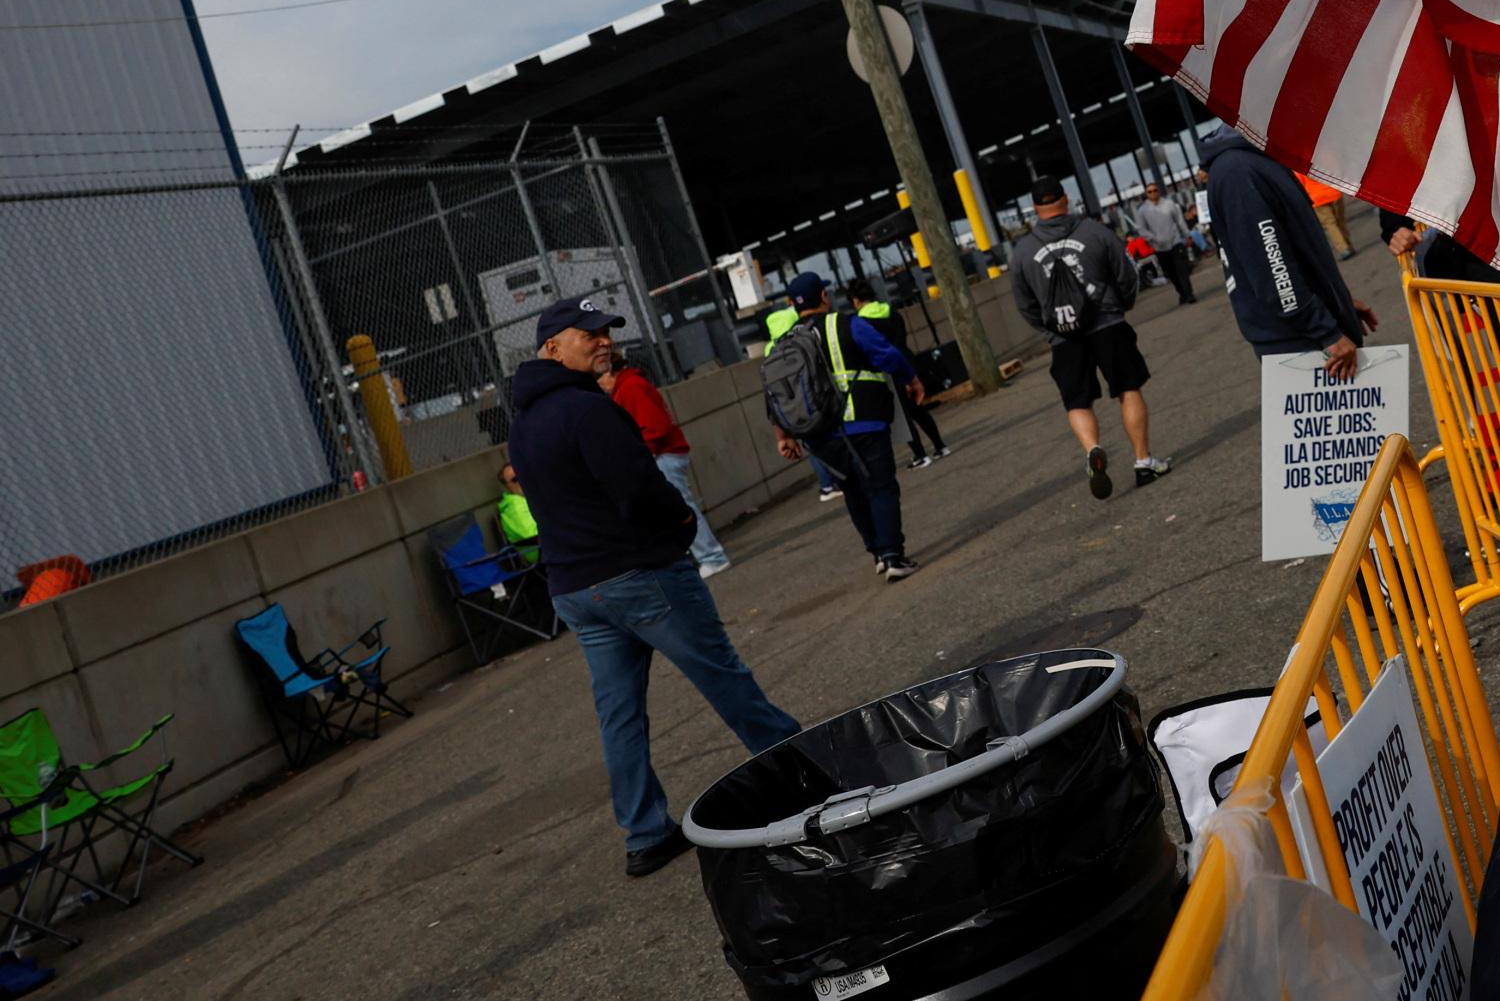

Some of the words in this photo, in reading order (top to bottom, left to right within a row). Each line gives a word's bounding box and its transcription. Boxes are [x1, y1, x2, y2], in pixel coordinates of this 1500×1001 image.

[1257, 219, 1299, 313] LONGSHOREMEN
[1284, 387, 1385, 415] AUTOMATION,
[1293, 416, 1332, 439] SAVE
[1336, 412, 1376, 435] JOBS:
[1284, 443, 1308, 465] ILA
[1312, 435, 1386, 463] DEMANDS
[1283, 467, 1311, 489] JOB
[1314, 460, 1375, 486] SECURIT
[1323, 506, 1352, 519] I.L.A
[1333, 761, 1388, 879] PROFIT
[1377, 723, 1413, 812] OVER
[1361, 818, 1416, 932] PEOPLE
[1403, 802, 1424, 869] IS
